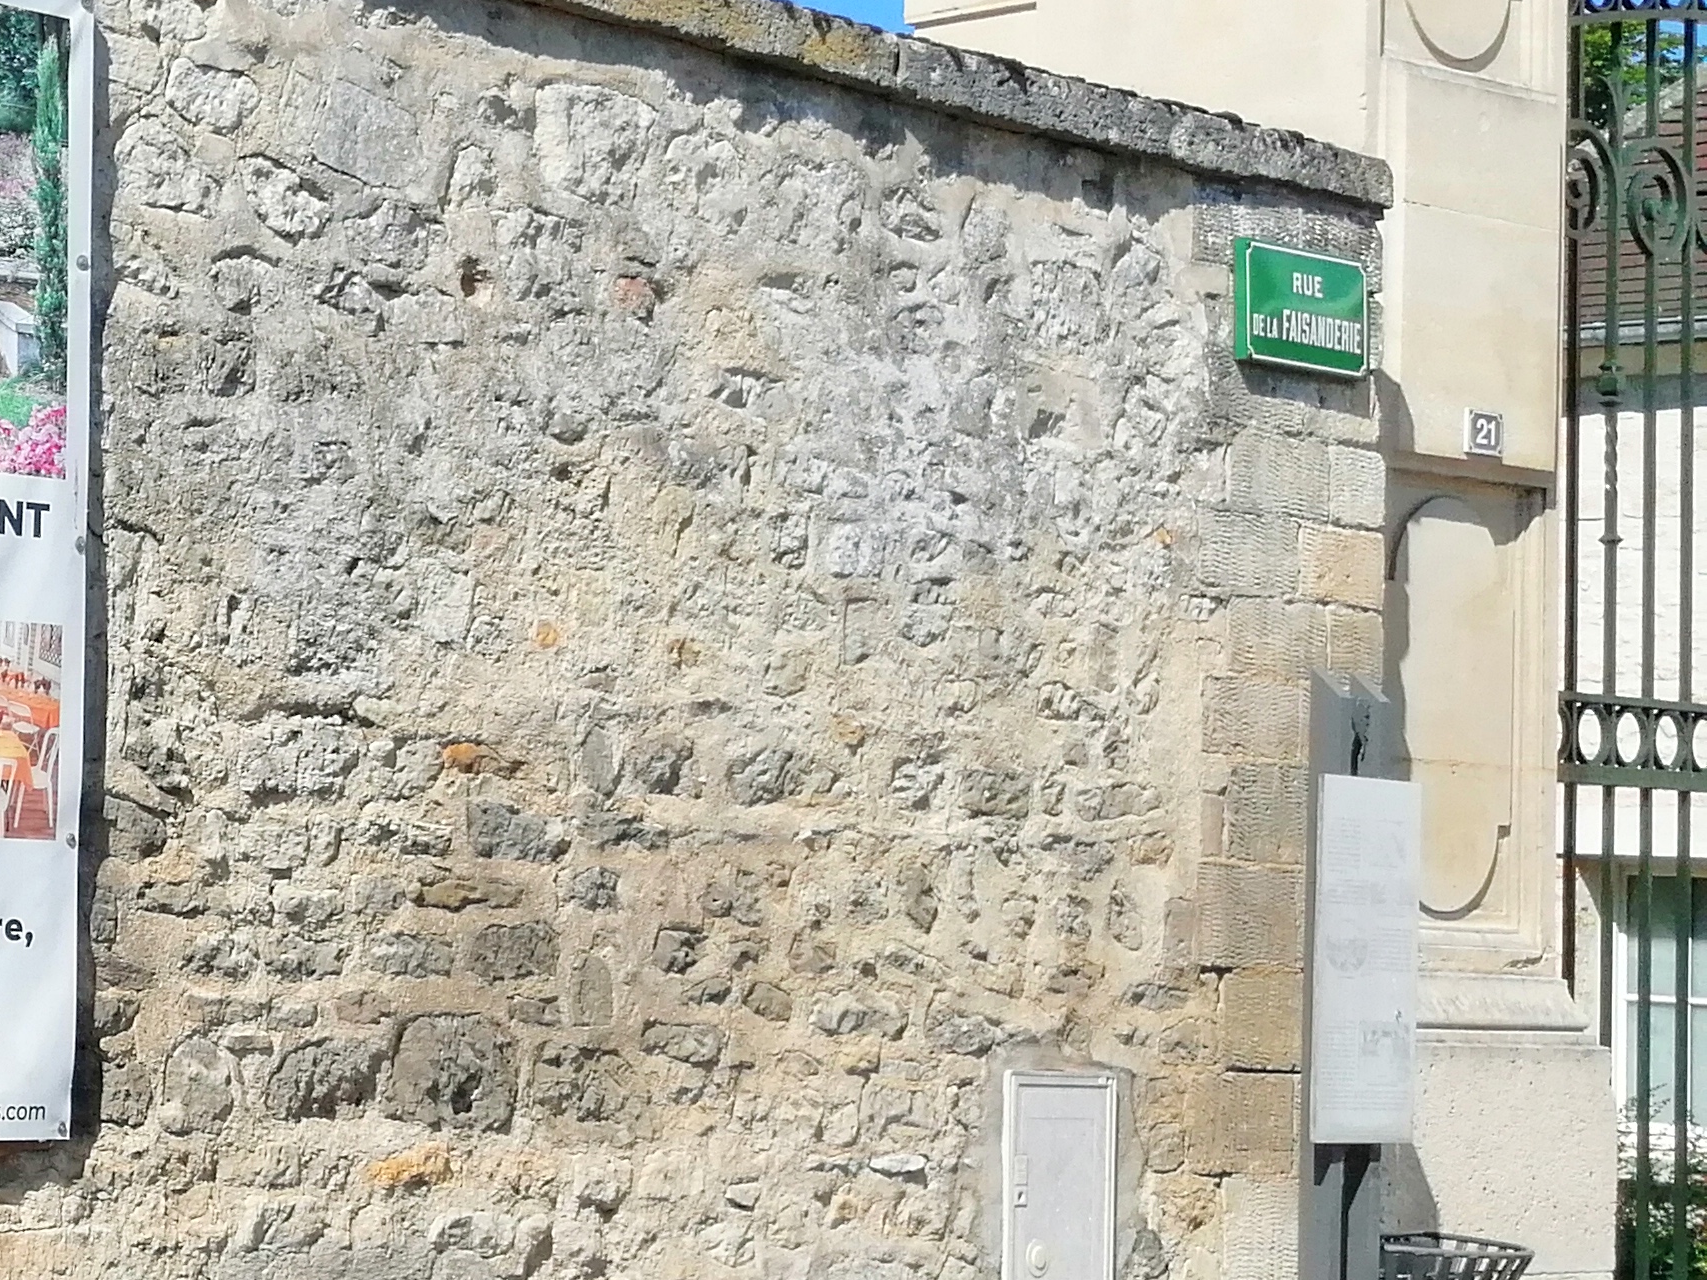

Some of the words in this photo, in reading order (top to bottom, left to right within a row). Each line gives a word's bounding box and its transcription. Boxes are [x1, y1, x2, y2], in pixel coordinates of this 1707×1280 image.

[1293, 272, 1323, 298] RUE
[1252, 313, 1265, 336] DE
[1267, 316, 1278, 338] LA
[1282, 308, 1361, 354] FAISANDERIE
[1476, 418, 1495, 446] 21
